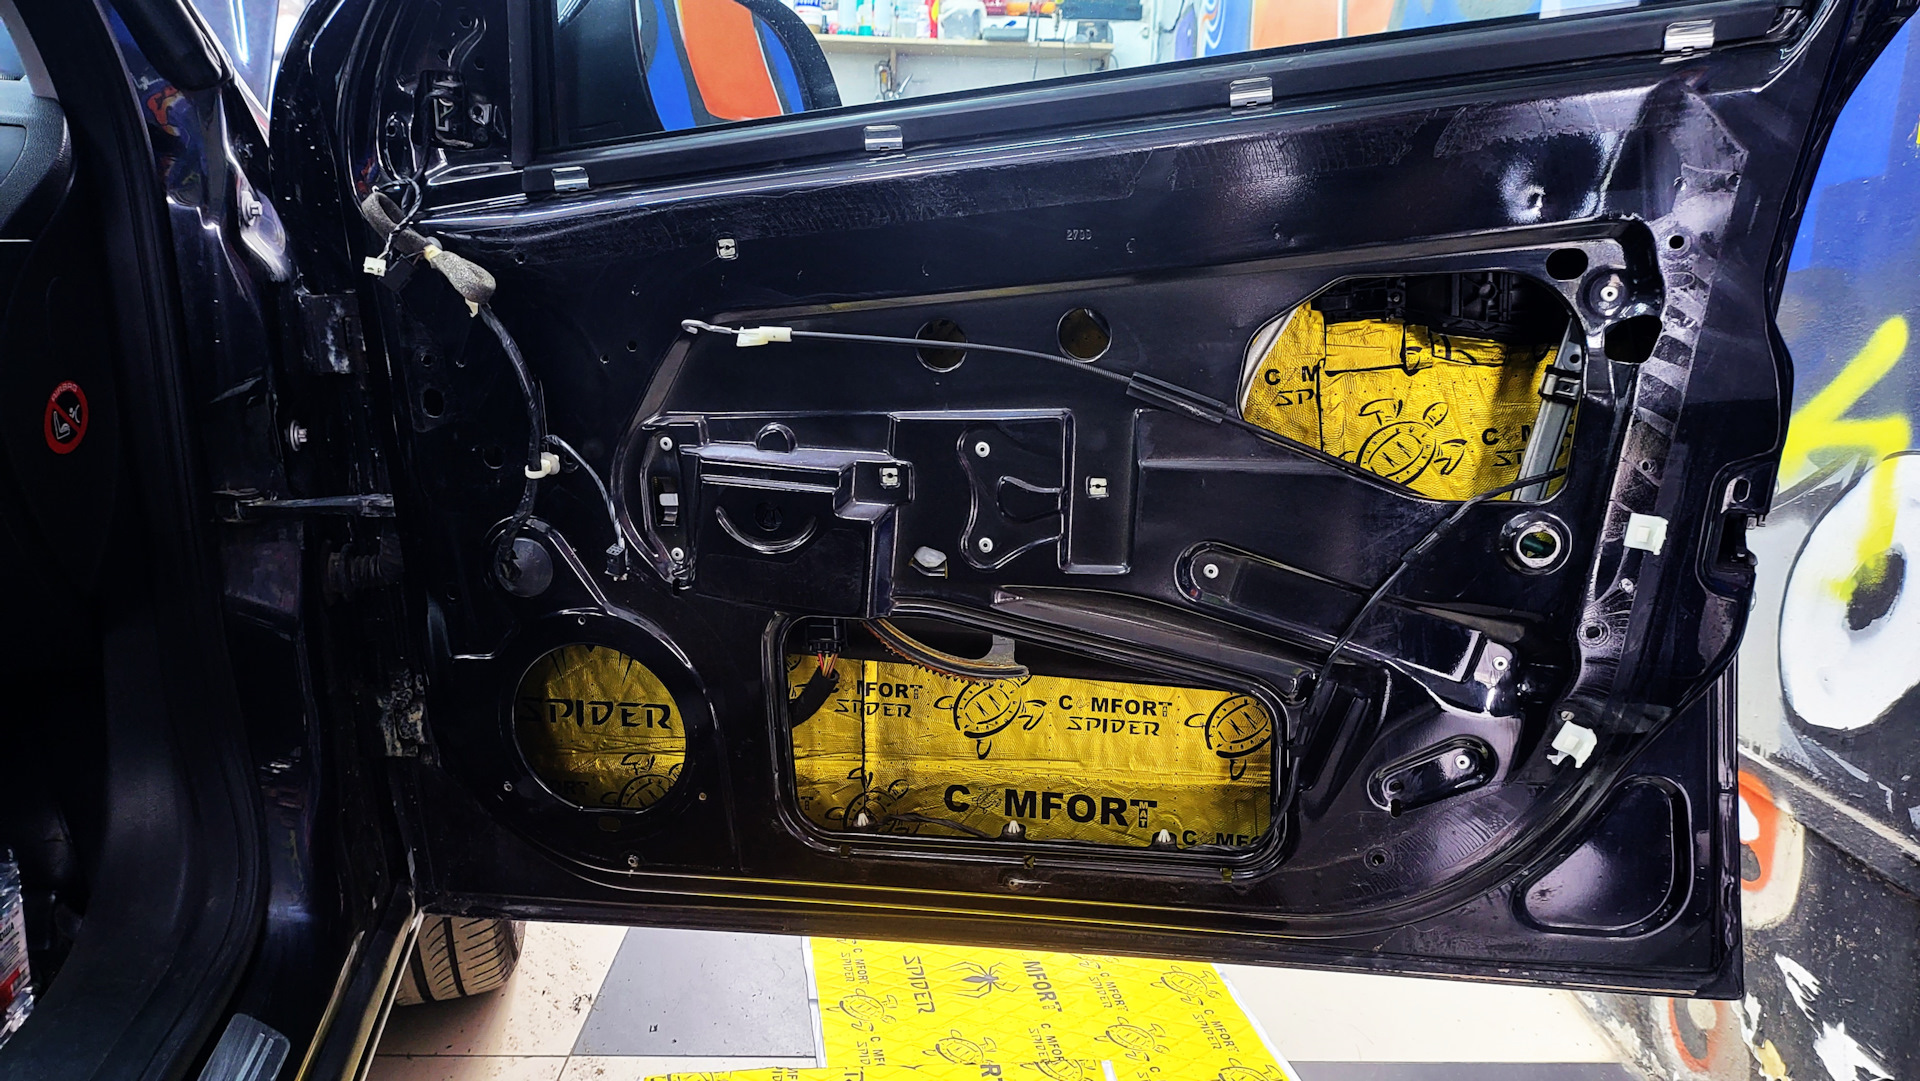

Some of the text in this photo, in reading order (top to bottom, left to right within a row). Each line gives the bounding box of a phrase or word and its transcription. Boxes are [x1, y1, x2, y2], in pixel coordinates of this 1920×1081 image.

[518, 697, 672, 729] SPIDER
[1066, 716, 1160, 736] SPIDER
[903, 955, 936, 1014] SPIDER
